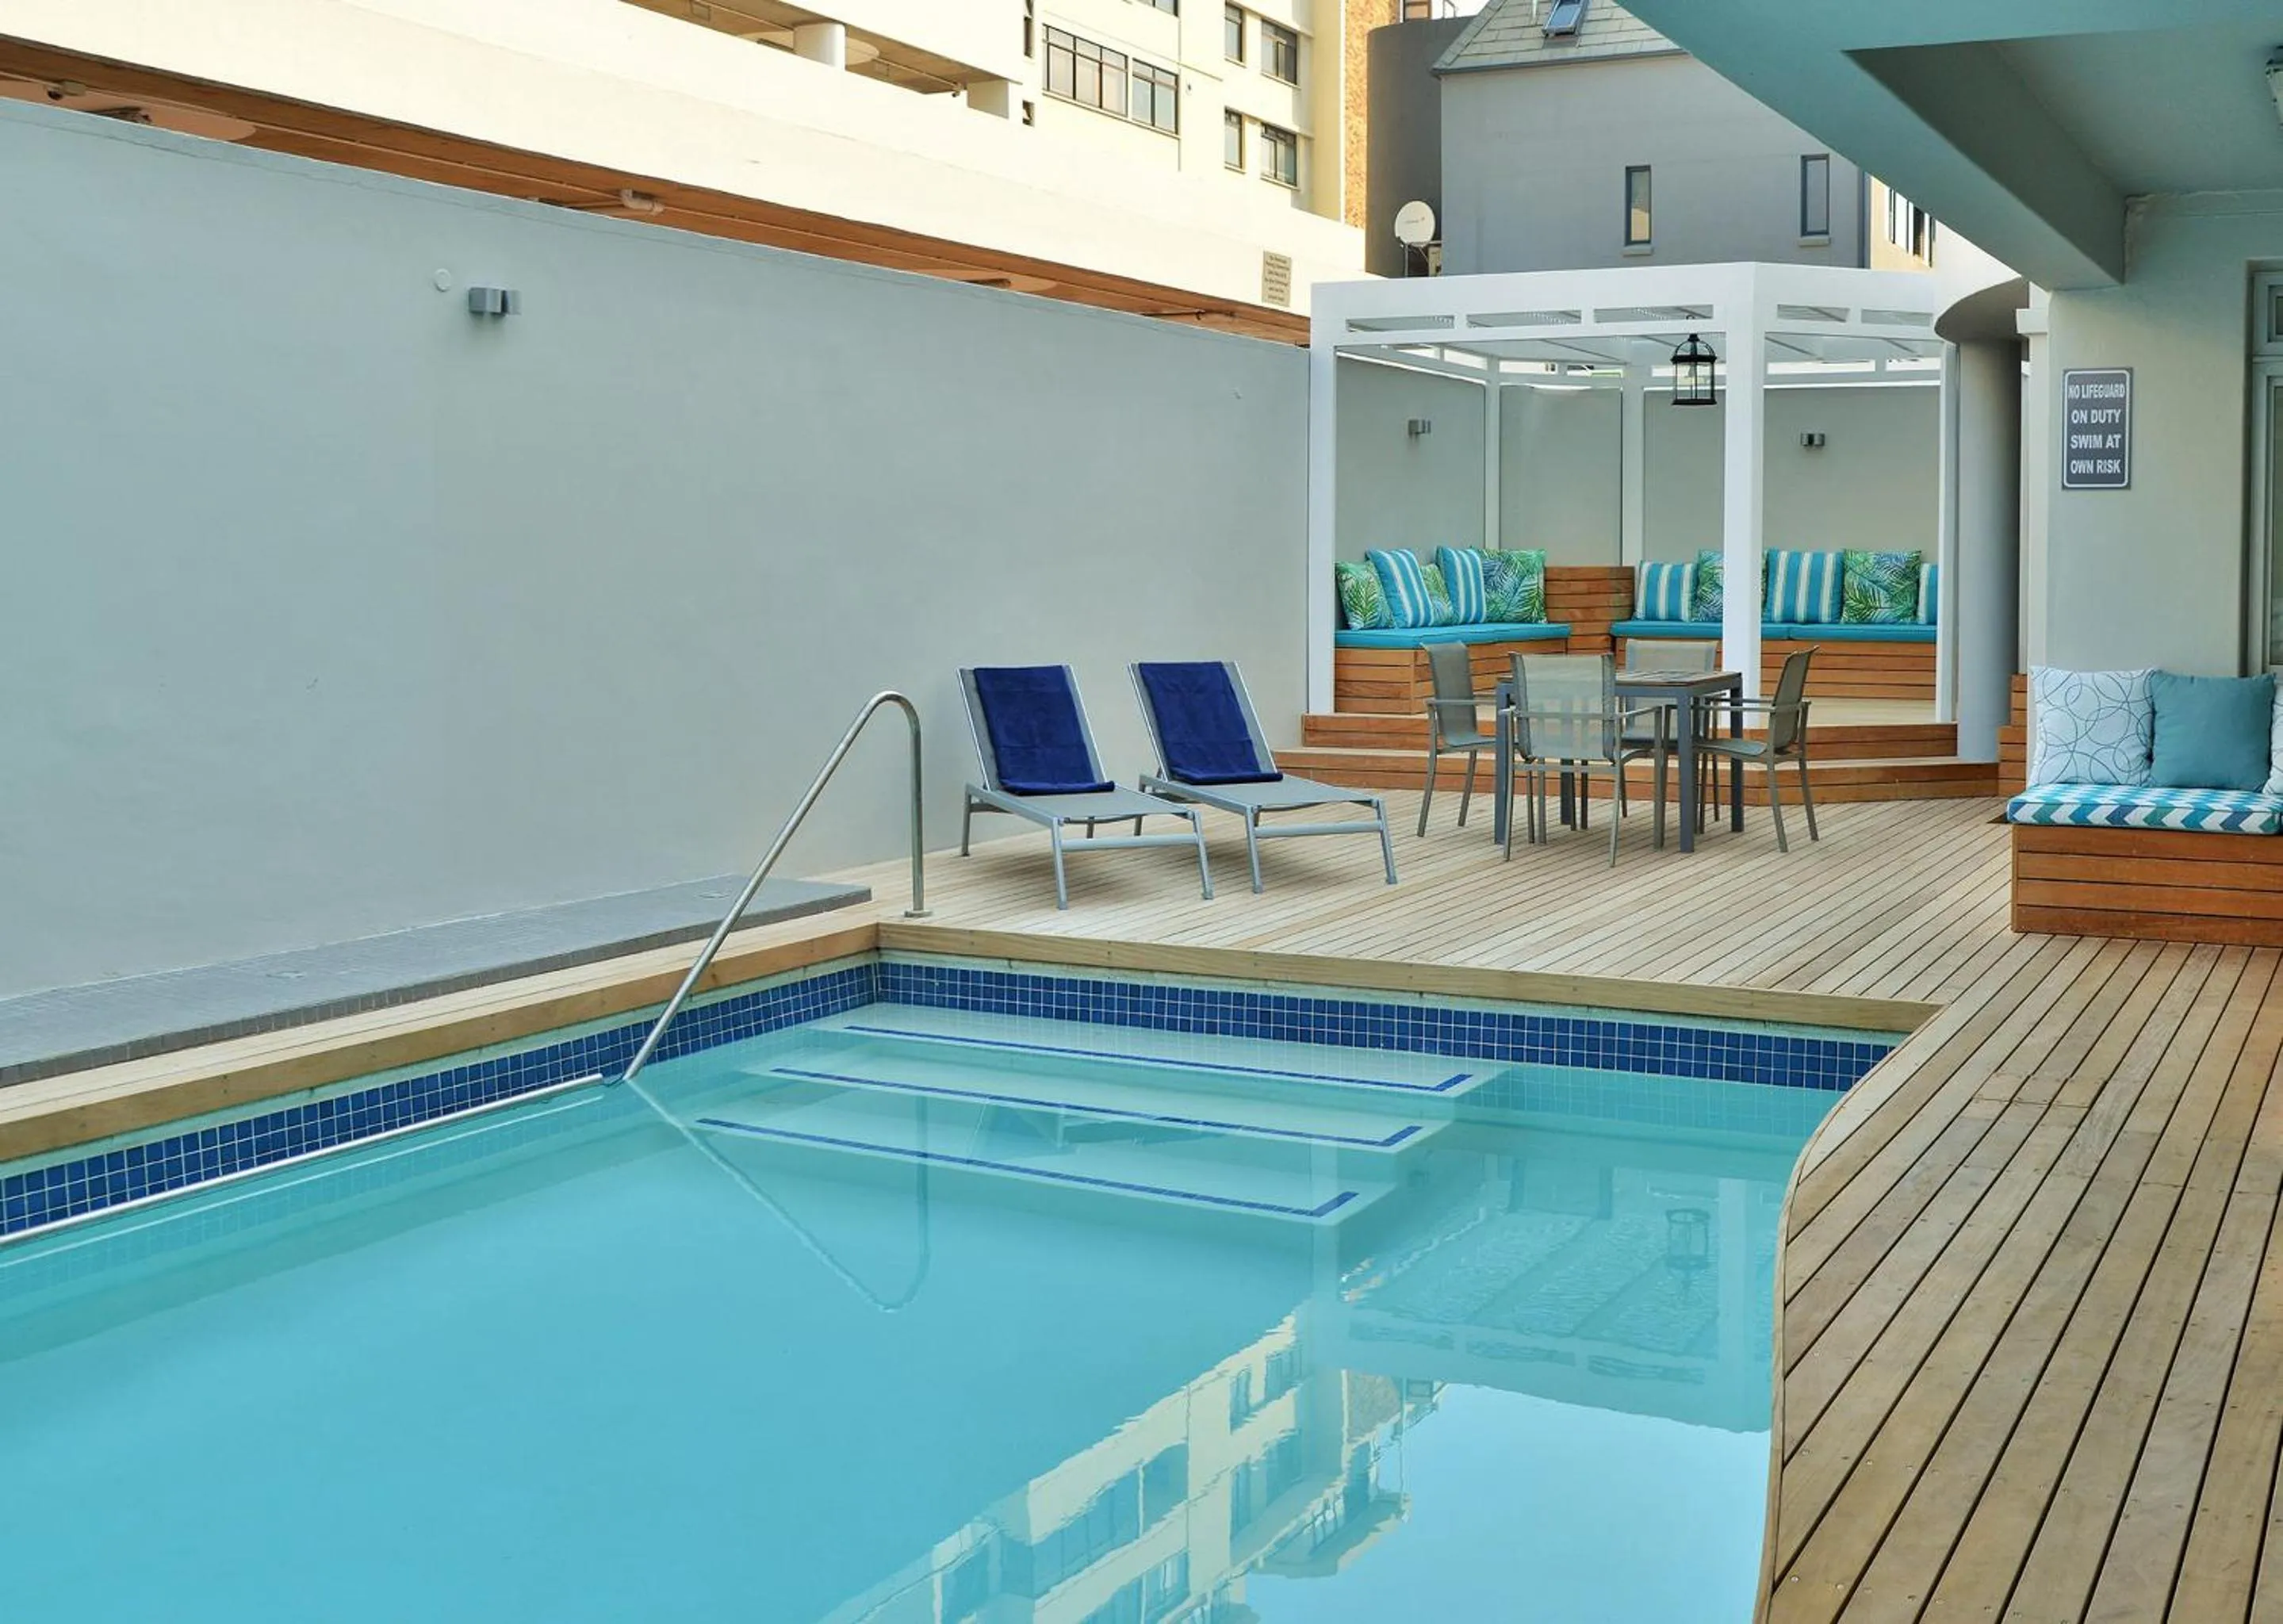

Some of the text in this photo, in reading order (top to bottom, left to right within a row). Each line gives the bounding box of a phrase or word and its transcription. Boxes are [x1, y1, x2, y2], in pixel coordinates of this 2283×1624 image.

[2067, 383, 2125, 399] NO LIFEGUARD
[2070, 408, 2122, 424] ON DUTY
[2070, 433, 2122, 449] SWIM AT
[2070, 459, 2121, 474] OWN RISK
